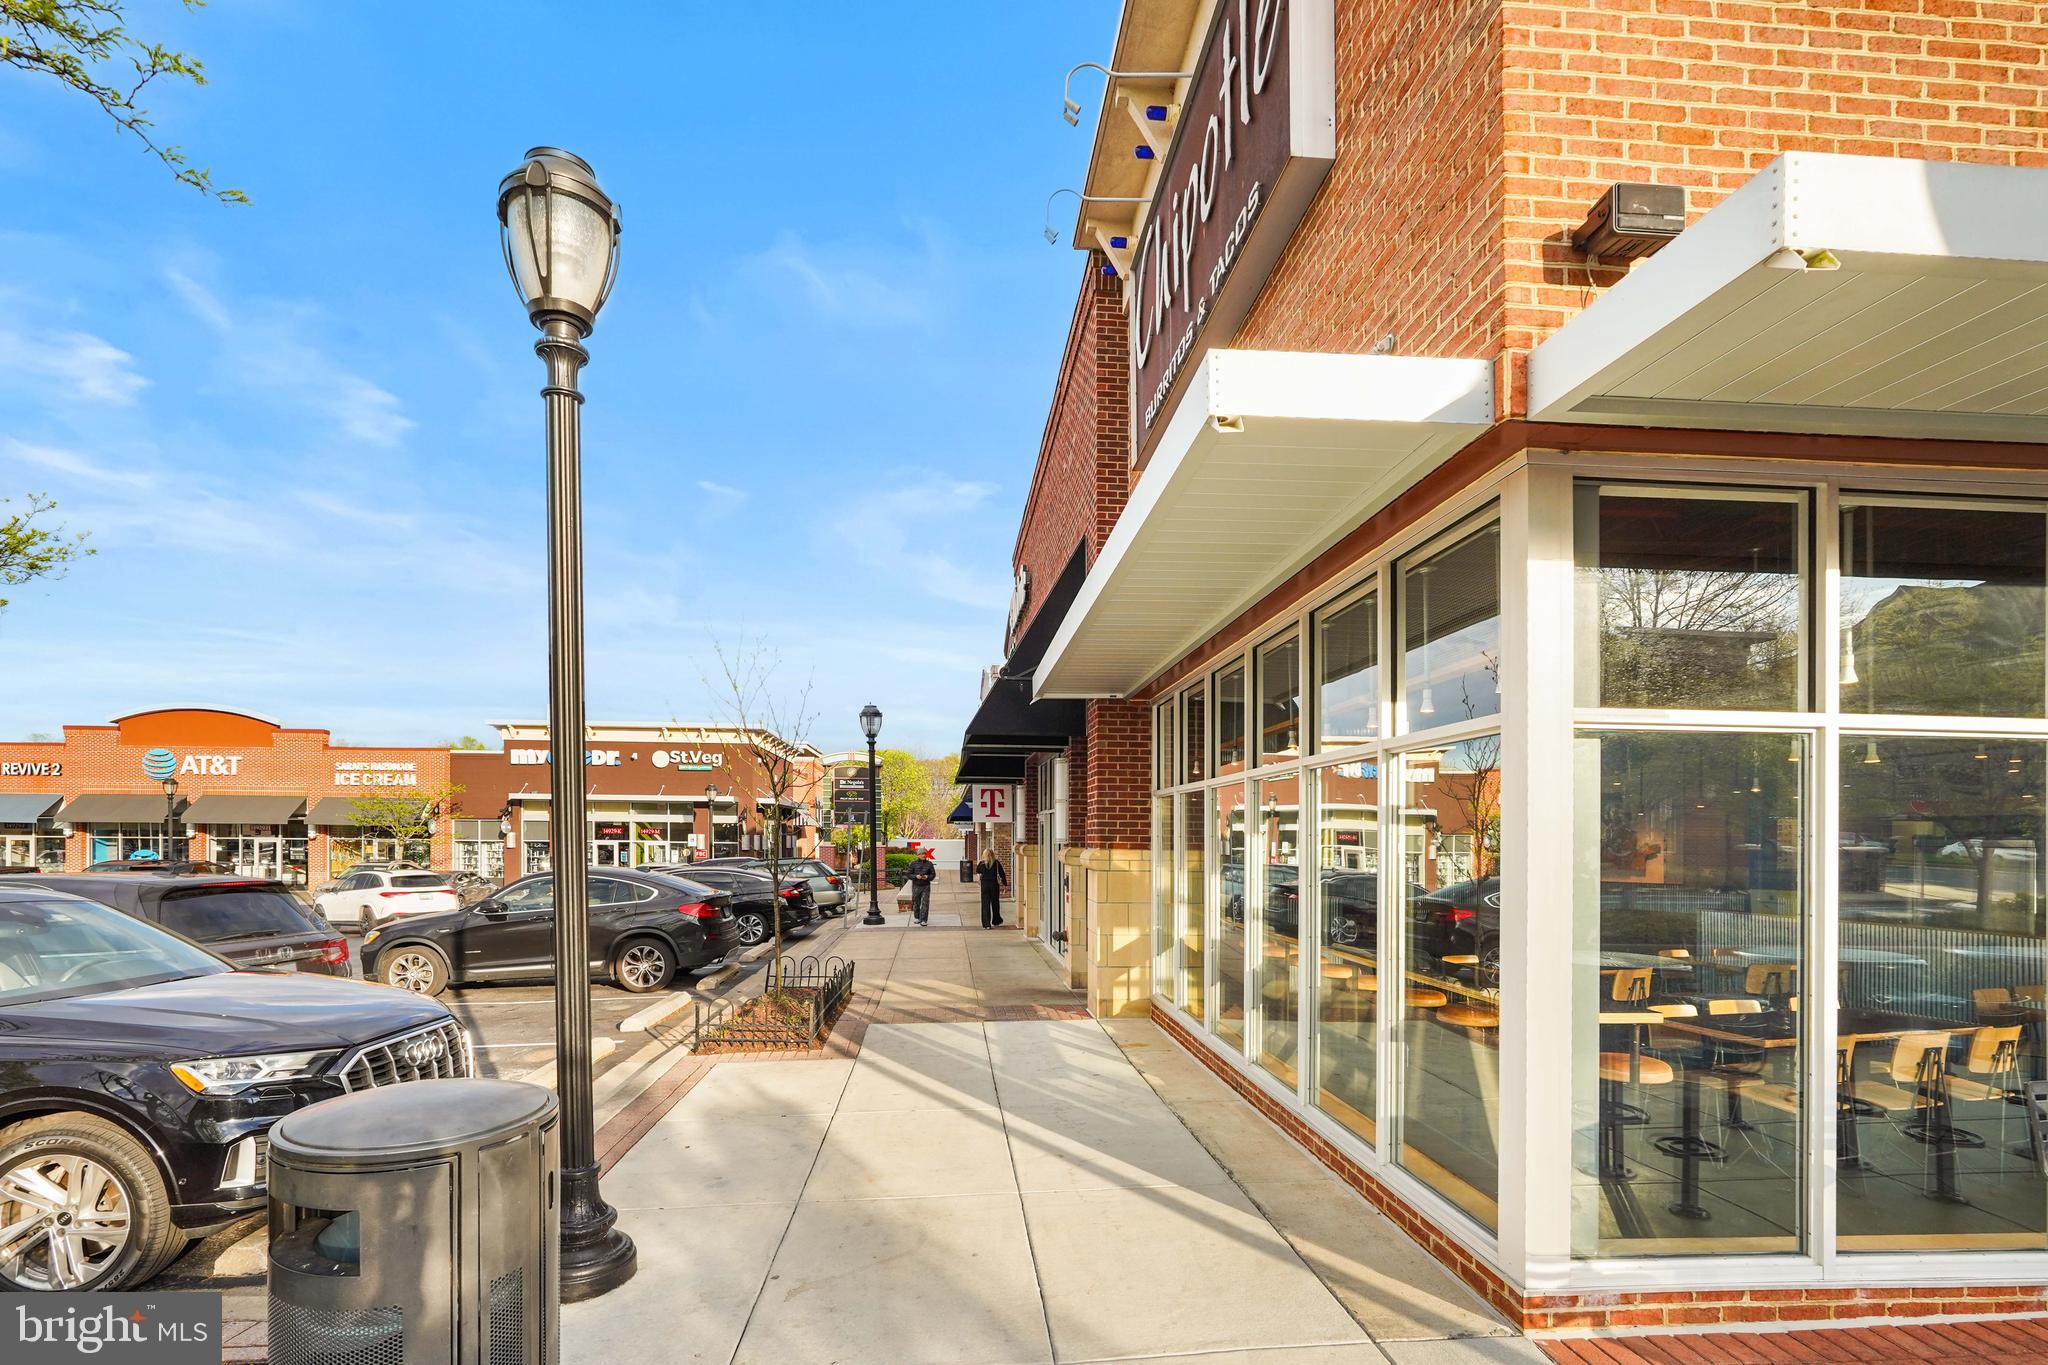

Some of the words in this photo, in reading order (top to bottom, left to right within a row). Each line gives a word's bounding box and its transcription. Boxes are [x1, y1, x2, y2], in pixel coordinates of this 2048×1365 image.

[1145, 320, 1194, 430] BURRITOS
[1197, 296, 1208, 326] &
[1208, 180, 1260, 297] TACOS
[179, 755, 243, 776] AT&T
[510, 748, 622, 767] myDr.
[669, 750, 723, 767] St.Veg
[2, 763, 49, 776] REVIVE
[51, 763, 62, 776] 2
[335, 773, 360, 786] ICE
[362, 773, 417, 786] CREAM
[981, 789, 1005, 818] T
